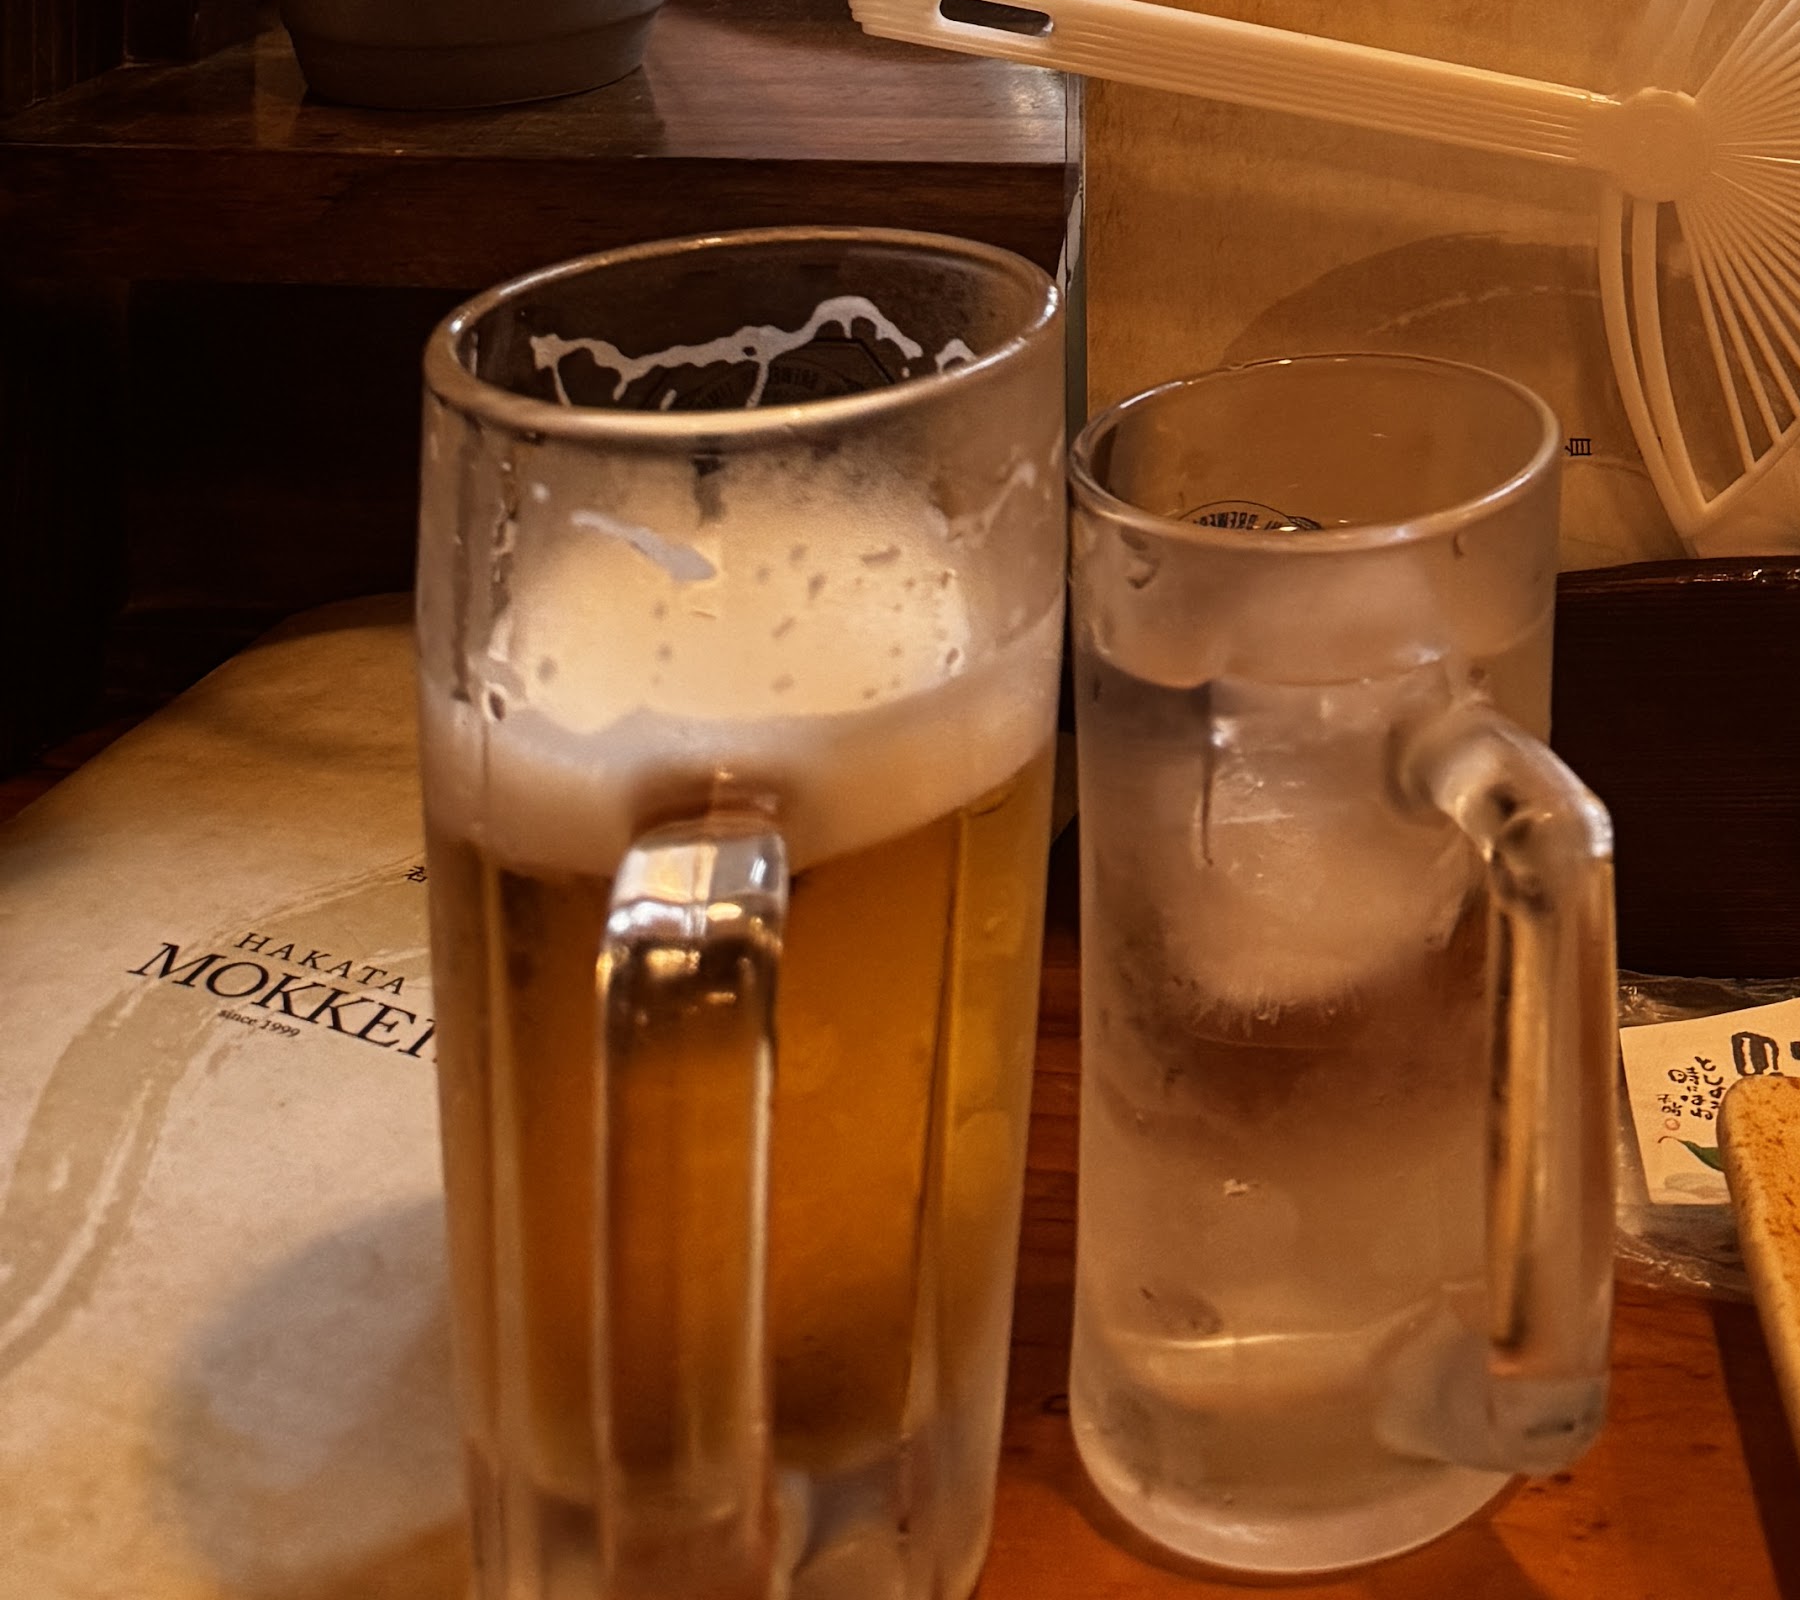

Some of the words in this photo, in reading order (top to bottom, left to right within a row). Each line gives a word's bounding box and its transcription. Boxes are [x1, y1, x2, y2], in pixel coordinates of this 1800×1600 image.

[234, 931, 408, 997] HAKATA
[218, 1007, 259, 1030] since
[260, 1017, 302, 1039] 1999
